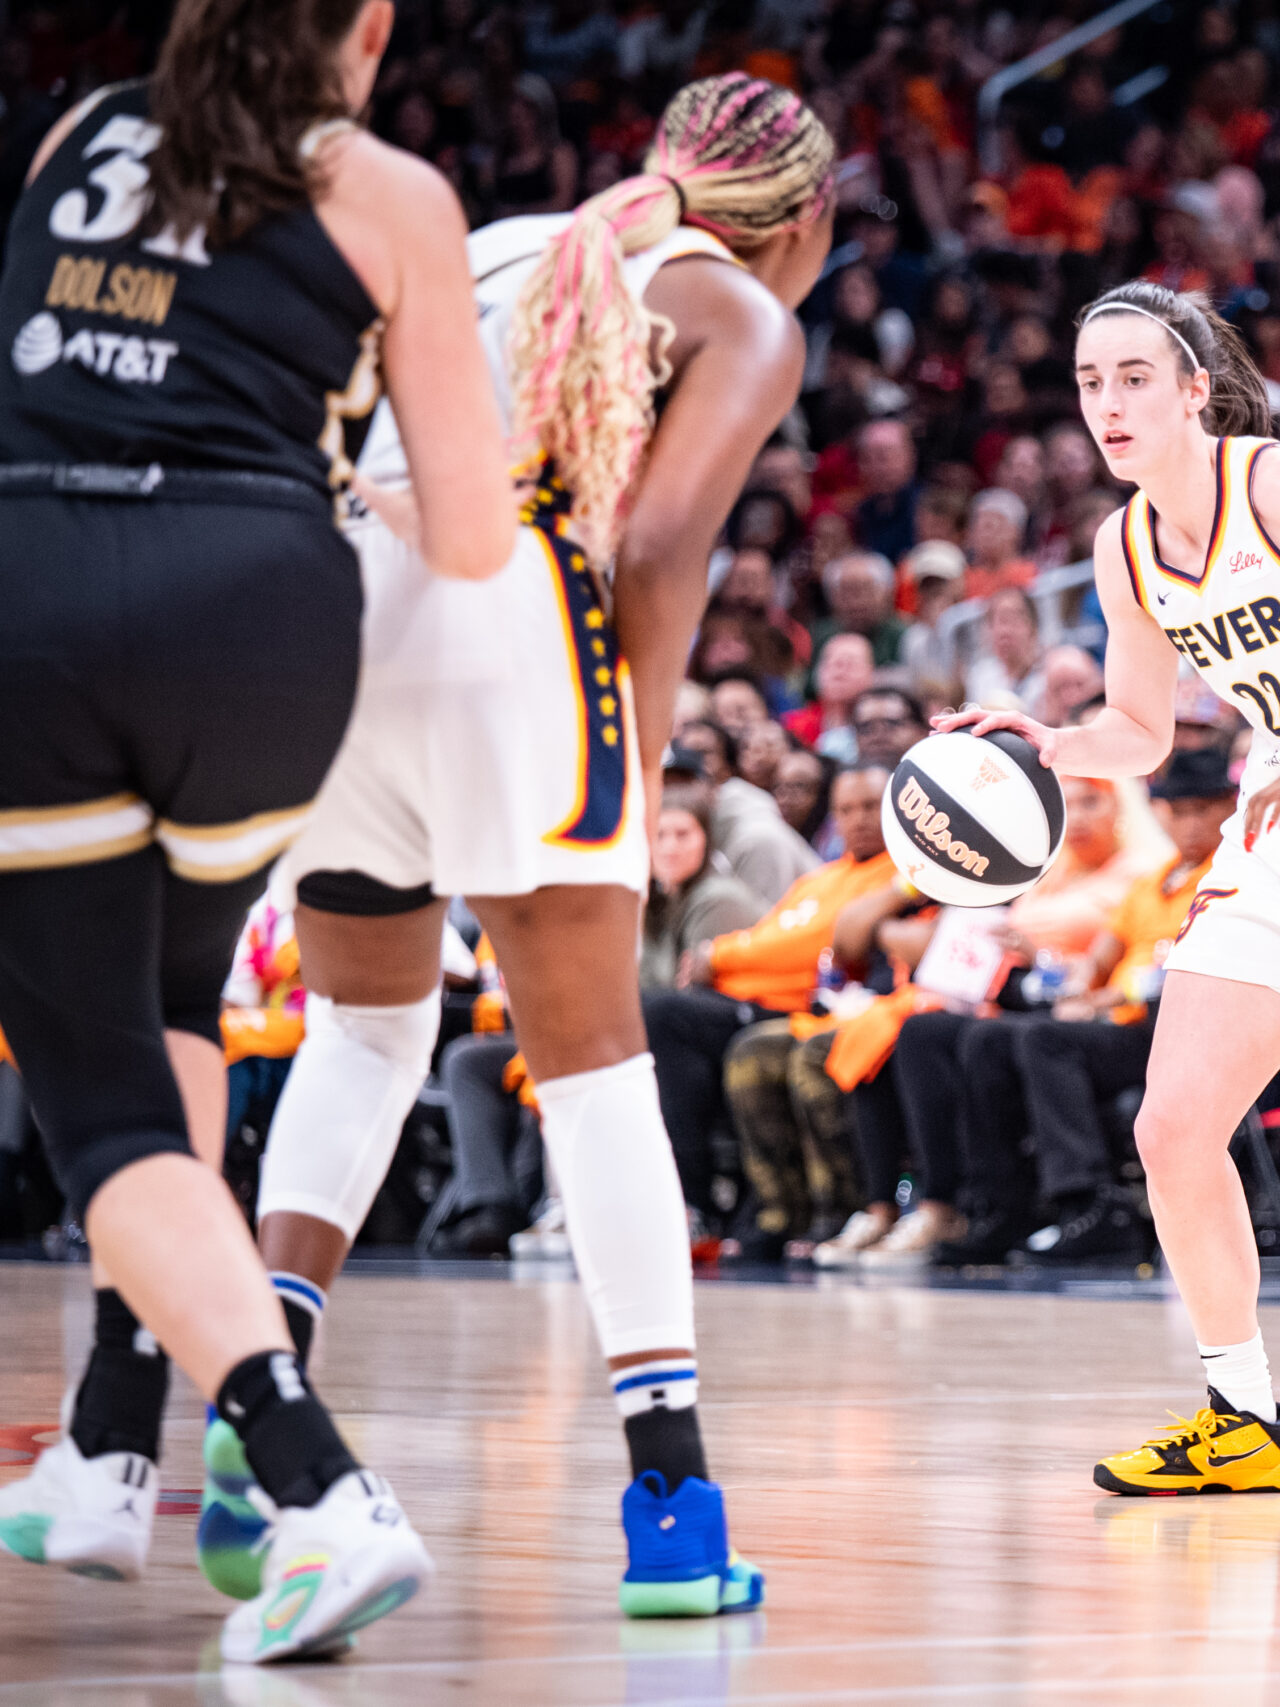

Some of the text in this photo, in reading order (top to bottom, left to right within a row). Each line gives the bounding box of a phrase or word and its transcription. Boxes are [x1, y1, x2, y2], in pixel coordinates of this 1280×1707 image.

[45, 253, 178, 327] DOLSON
[62, 327, 179, 384] AT&T
[1229, 550, 1264, 575] Lilly
[898, 775, 990, 877] Wilson
